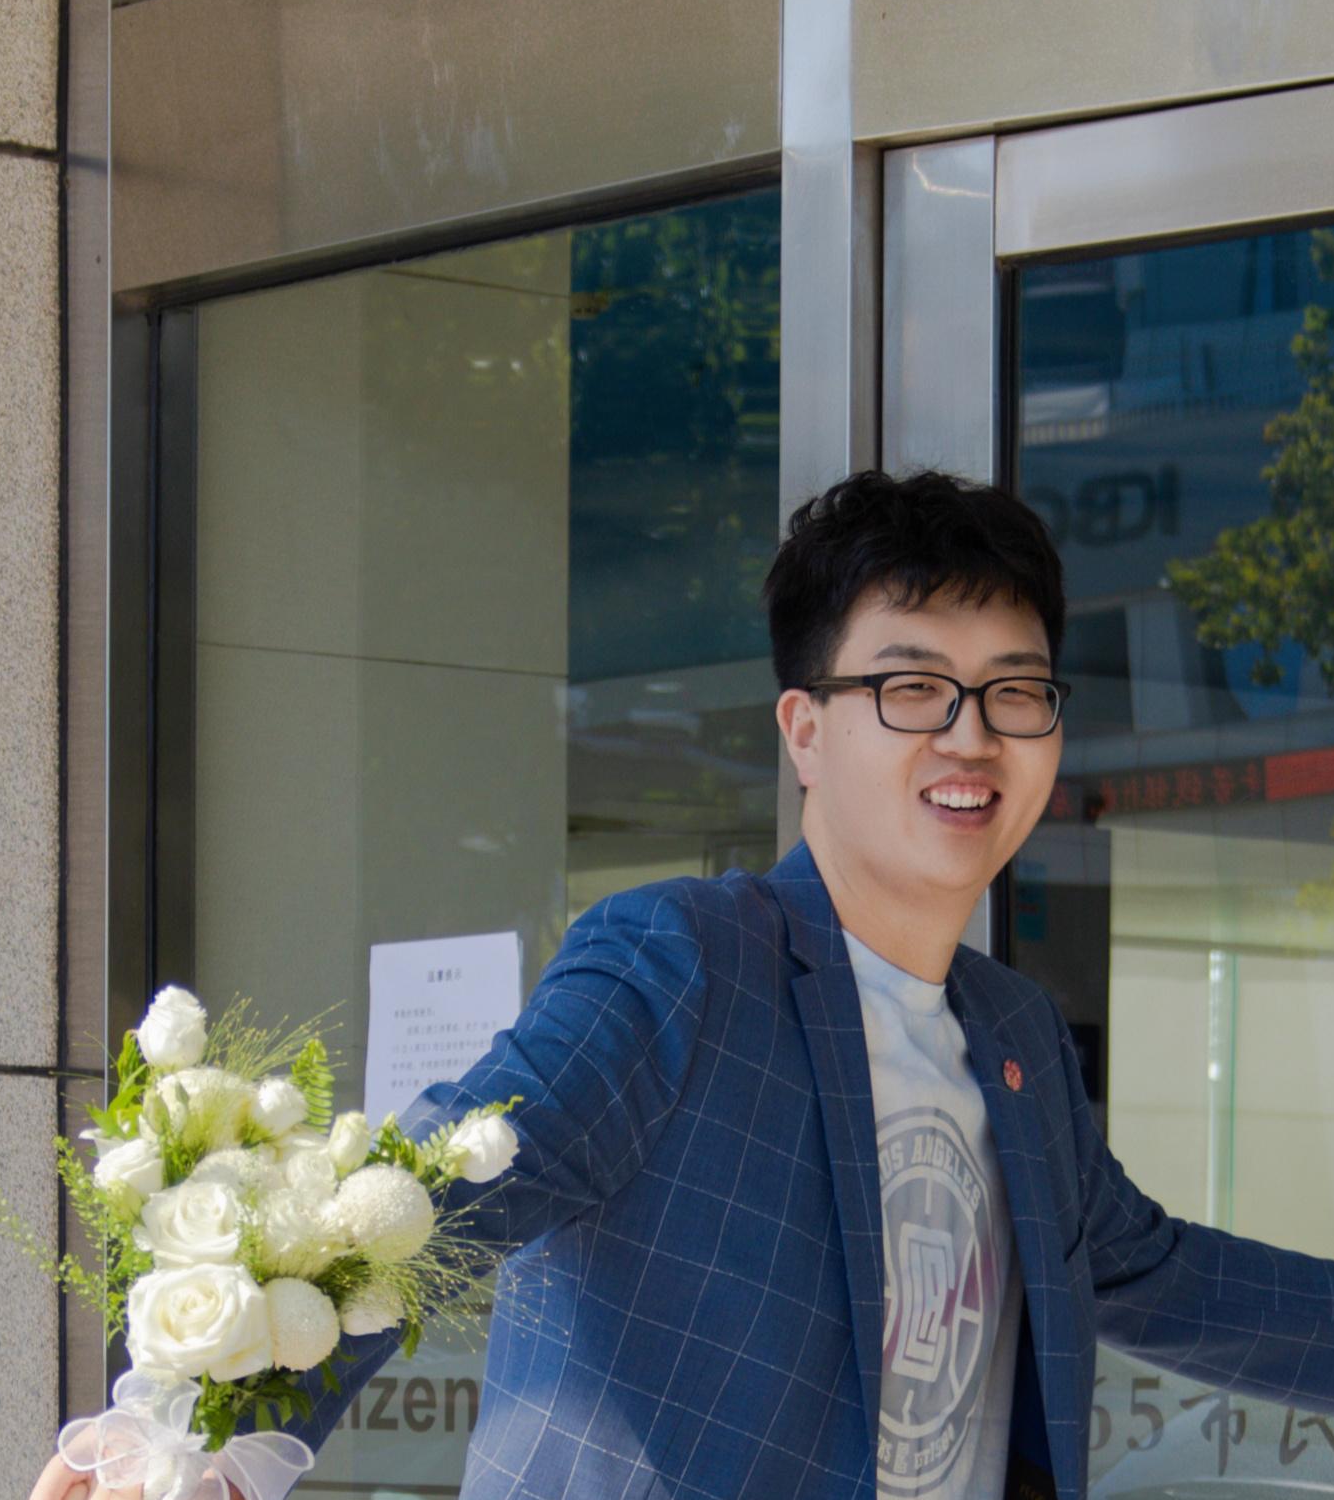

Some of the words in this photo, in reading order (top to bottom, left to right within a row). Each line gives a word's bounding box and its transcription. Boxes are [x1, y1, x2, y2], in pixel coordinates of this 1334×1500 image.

[879, 1140, 905, 1186] OS
[910, 1132, 982, 1213] ANGELES
[335, 1375, 480, 1433] izen
